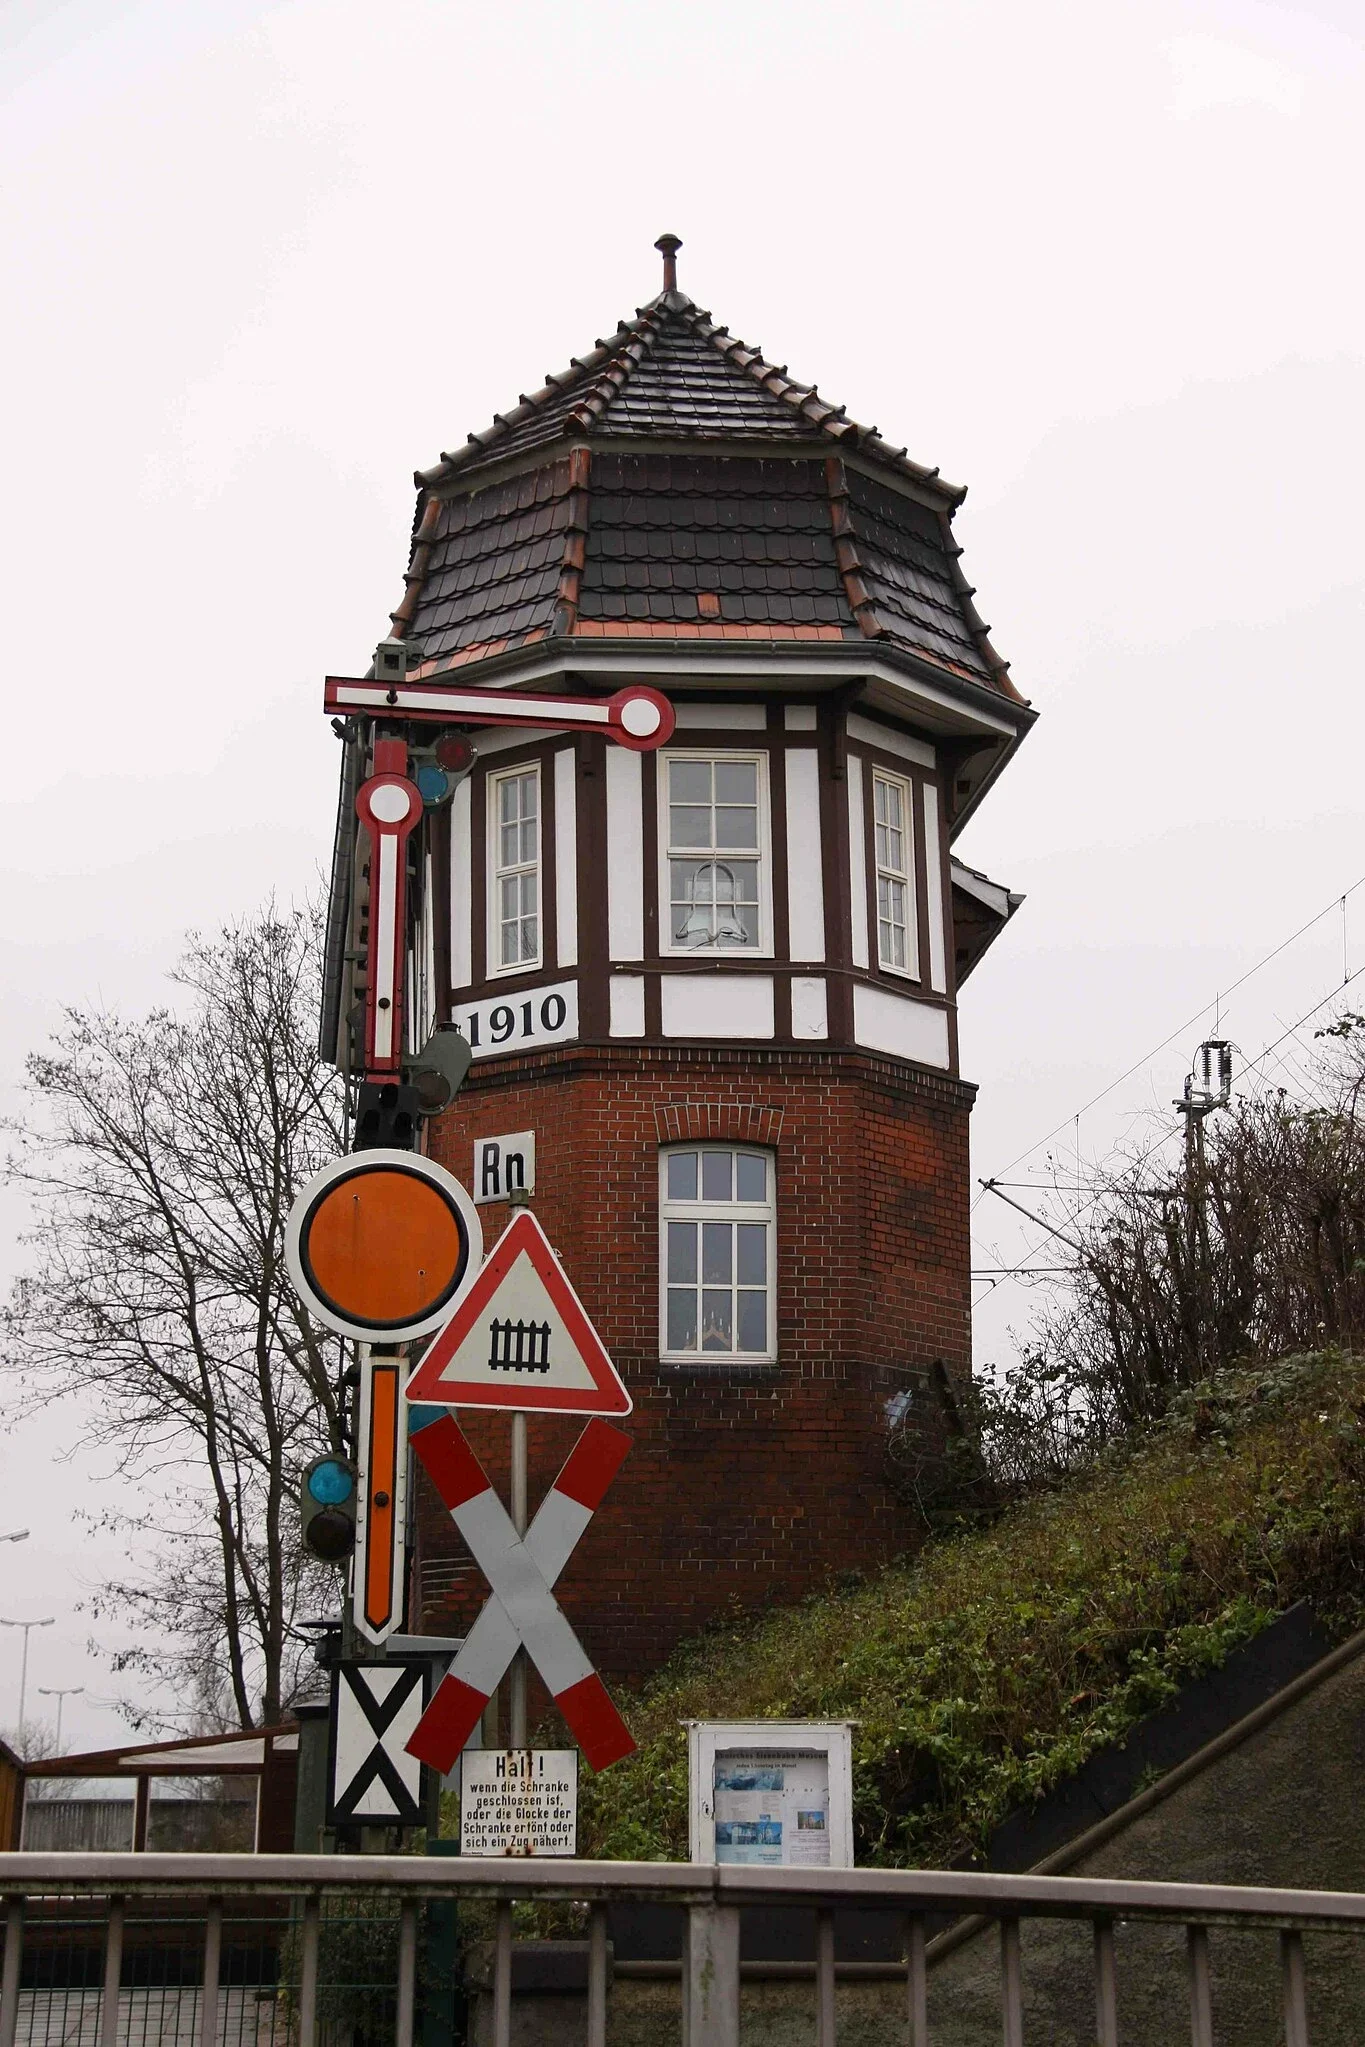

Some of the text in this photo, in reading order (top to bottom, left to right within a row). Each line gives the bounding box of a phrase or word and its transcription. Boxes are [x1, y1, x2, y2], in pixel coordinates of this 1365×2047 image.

[467, 993, 567, 1048] 1910
[482, 1142, 525, 1197] Rn
[470, 1781, 569, 1792] wenn die Schranke
[477, 1794, 563, 1809] geschlossen ist,
[467, 1808, 571, 1820] oder die Glocke der
[464, 1821, 573, 1834] Schranke ertönt oder
[466, 1835, 572, 1848] sich ein Zug nähert.
